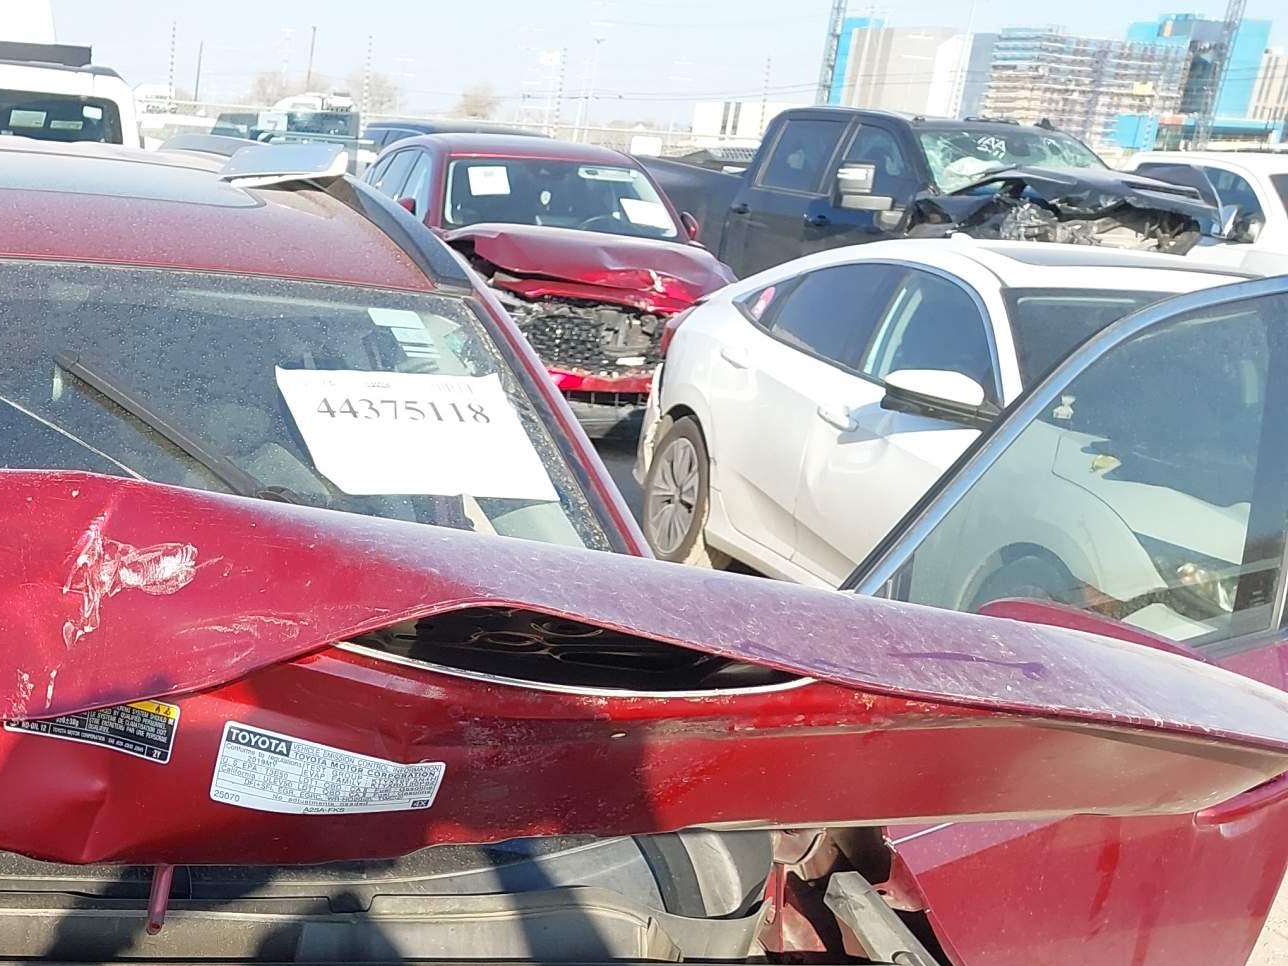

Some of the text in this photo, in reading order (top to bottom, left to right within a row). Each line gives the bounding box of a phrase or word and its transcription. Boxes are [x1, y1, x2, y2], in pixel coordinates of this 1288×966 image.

[317, 397, 490, 424] 44375118
[230, 728, 288, 754] TOYOTA
[293, 743, 321, 755] VEHICLE
[323, 751, 355, 763] EMISSION
[359, 759, 388, 770] CONTROL
[221, 764, 256, 778] California
[294, 752, 435, 780] TOYOTA MOTOR CORPORATION
[304, 763, 362, 780] TEST GROUP
[303, 769, 326, 779] EVAP
[333, 776, 361, 786] FAMILY
